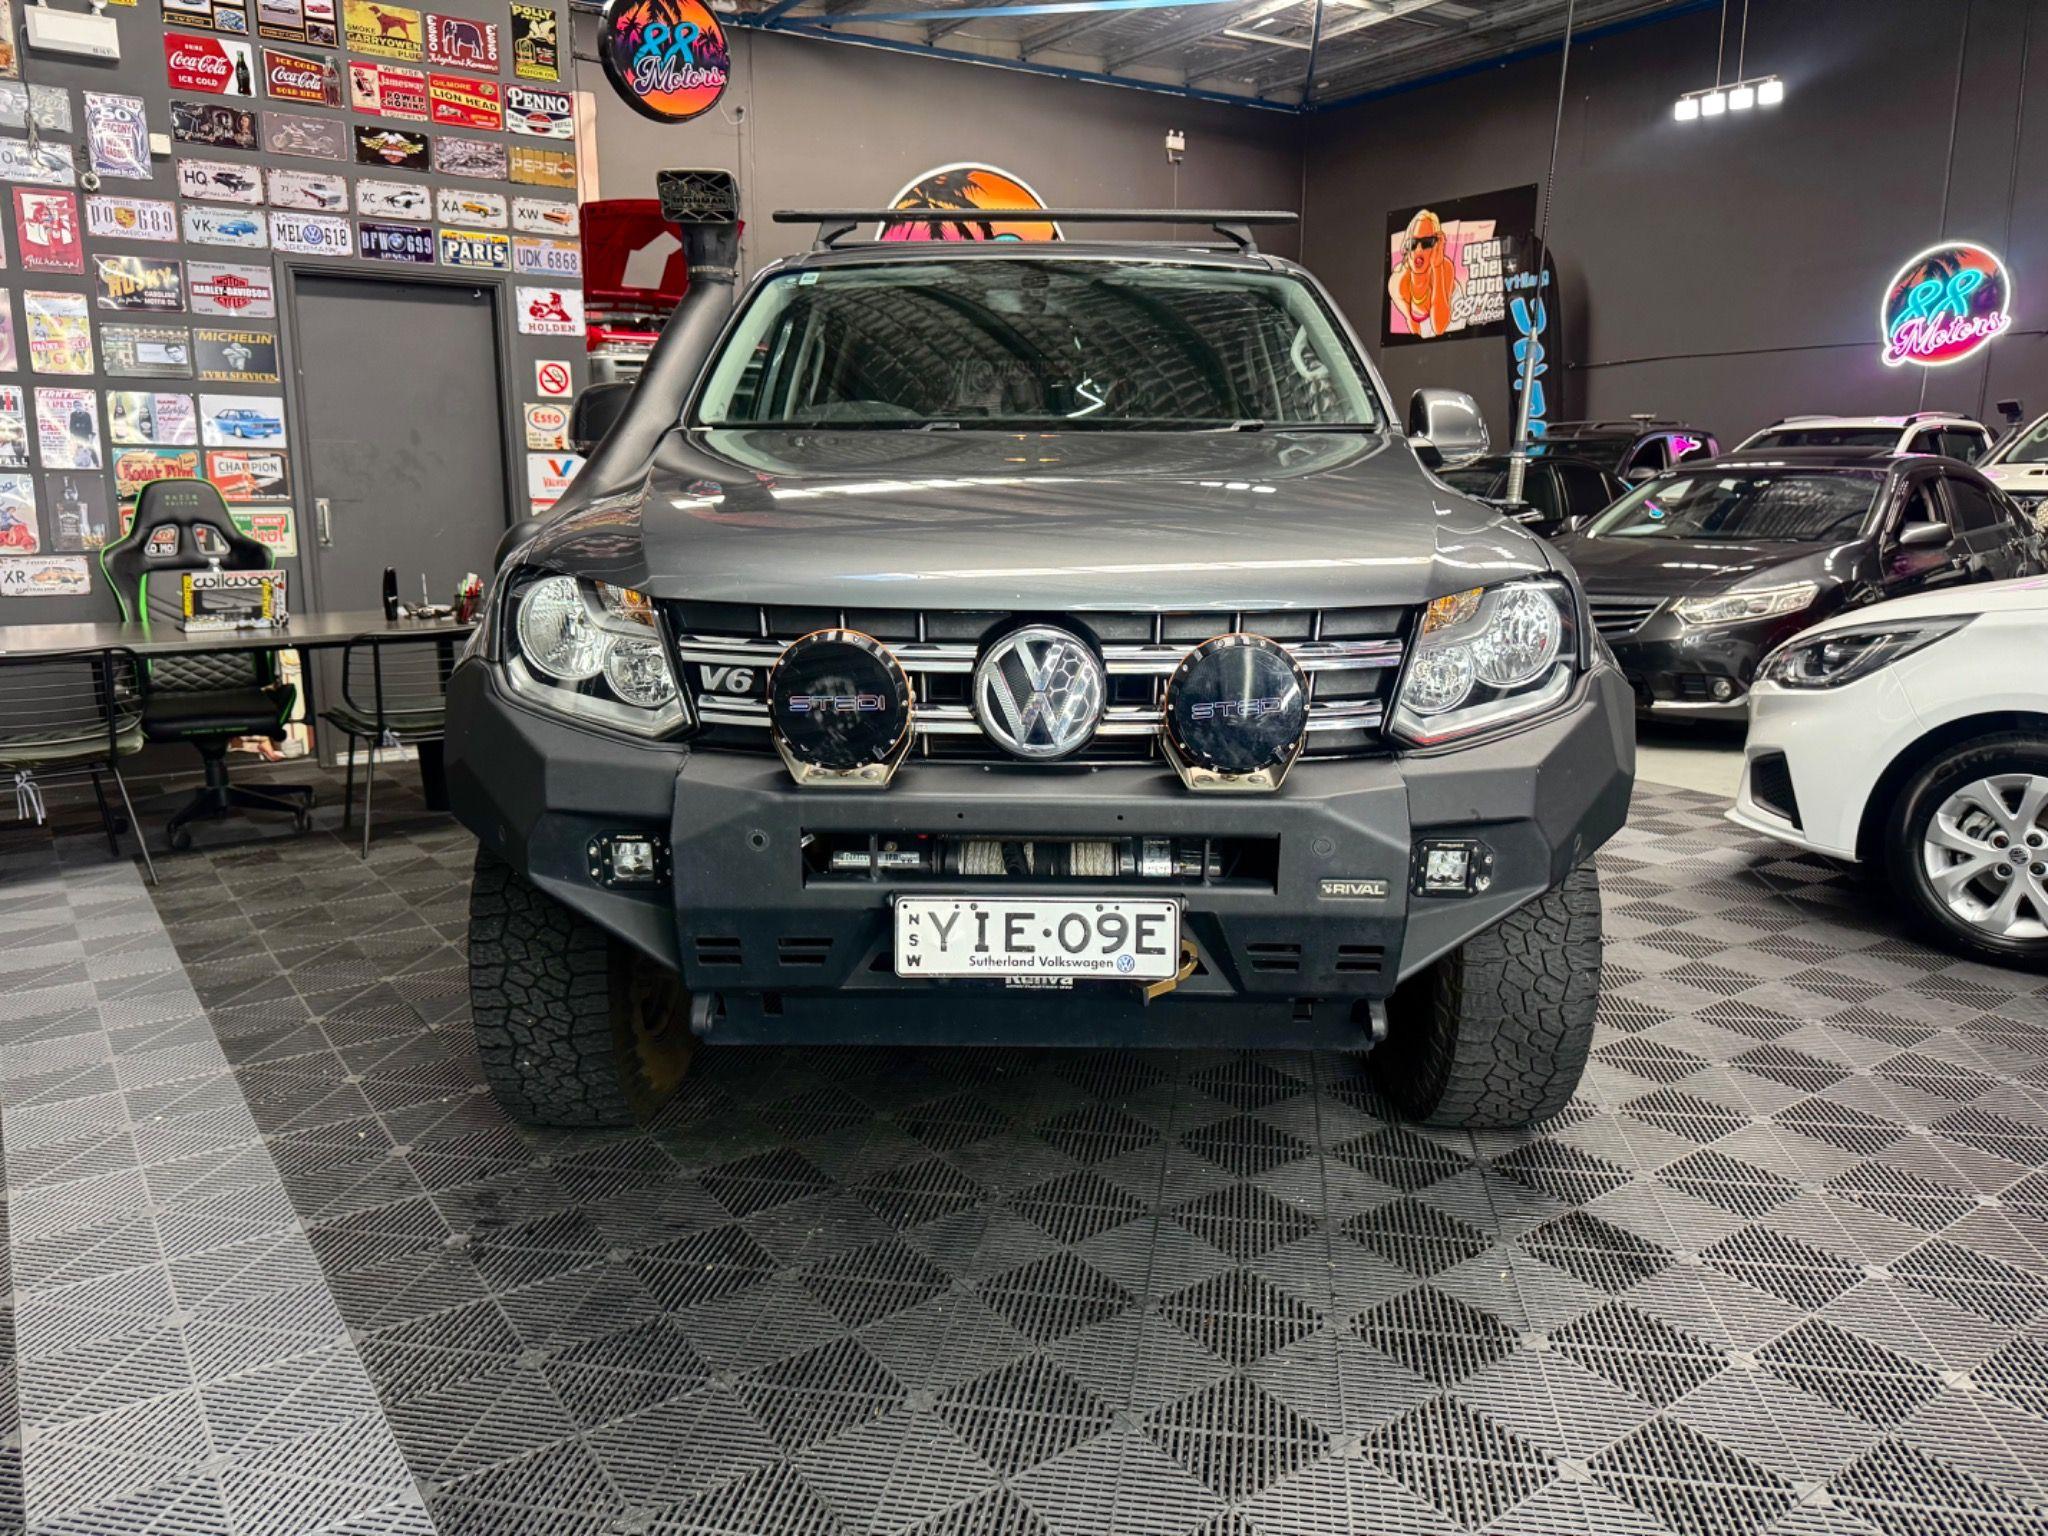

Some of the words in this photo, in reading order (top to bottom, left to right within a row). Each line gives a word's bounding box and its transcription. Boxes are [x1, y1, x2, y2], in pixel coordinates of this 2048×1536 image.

[512, 5, 553, 20] POLLY
[347, 24, 376, 35] SMOKE
[633, 22, 700, 68] 88
[275, 56, 292, 65] ICE
[294, 61, 318, 70] COLD
[178, 75, 193, 84] ICE
[196, 77, 219, 87] COLD
[633, 55, 728, 95] Motors
[387, 92, 425, 103] POWER
[433, 88, 462, 102] LION
[465, 96, 498, 112] HEAD
[508, 87, 569, 113] PENNO
[511, 157, 558, 176] PEPSI
[442, 199, 461, 213] XA
[518, 207, 539, 220] XW
[276, 223, 303, 243] MEL
[406, 234, 432, 255] 699
[448, 241, 504, 261] PARIS
[517, 247, 543, 267] UDK
[547, 251, 578, 270] 6868
[1890, 268, 1984, 338] 88
[528, 323, 576, 333] HOLDEN
[199, 331, 273, 345] MICHELIN
[1884, 311, 2008, 364] Motors
[202, 370, 227, 380] TYRE
[230, 371, 277, 383] SERVICES
[122, 463, 163, 481] Kodak
[4, 570, 26, 584] XR
[193, 572, 285, 589] wilwood
[700, 665, 754, 693] V6
[789, 694, 886, 711] STEDI
[1333, 883, 1385, 895] RIVAL
[969, 955, 1035, 968] Sutherland
[1040, 956, 1114, 970] Volkswagen
